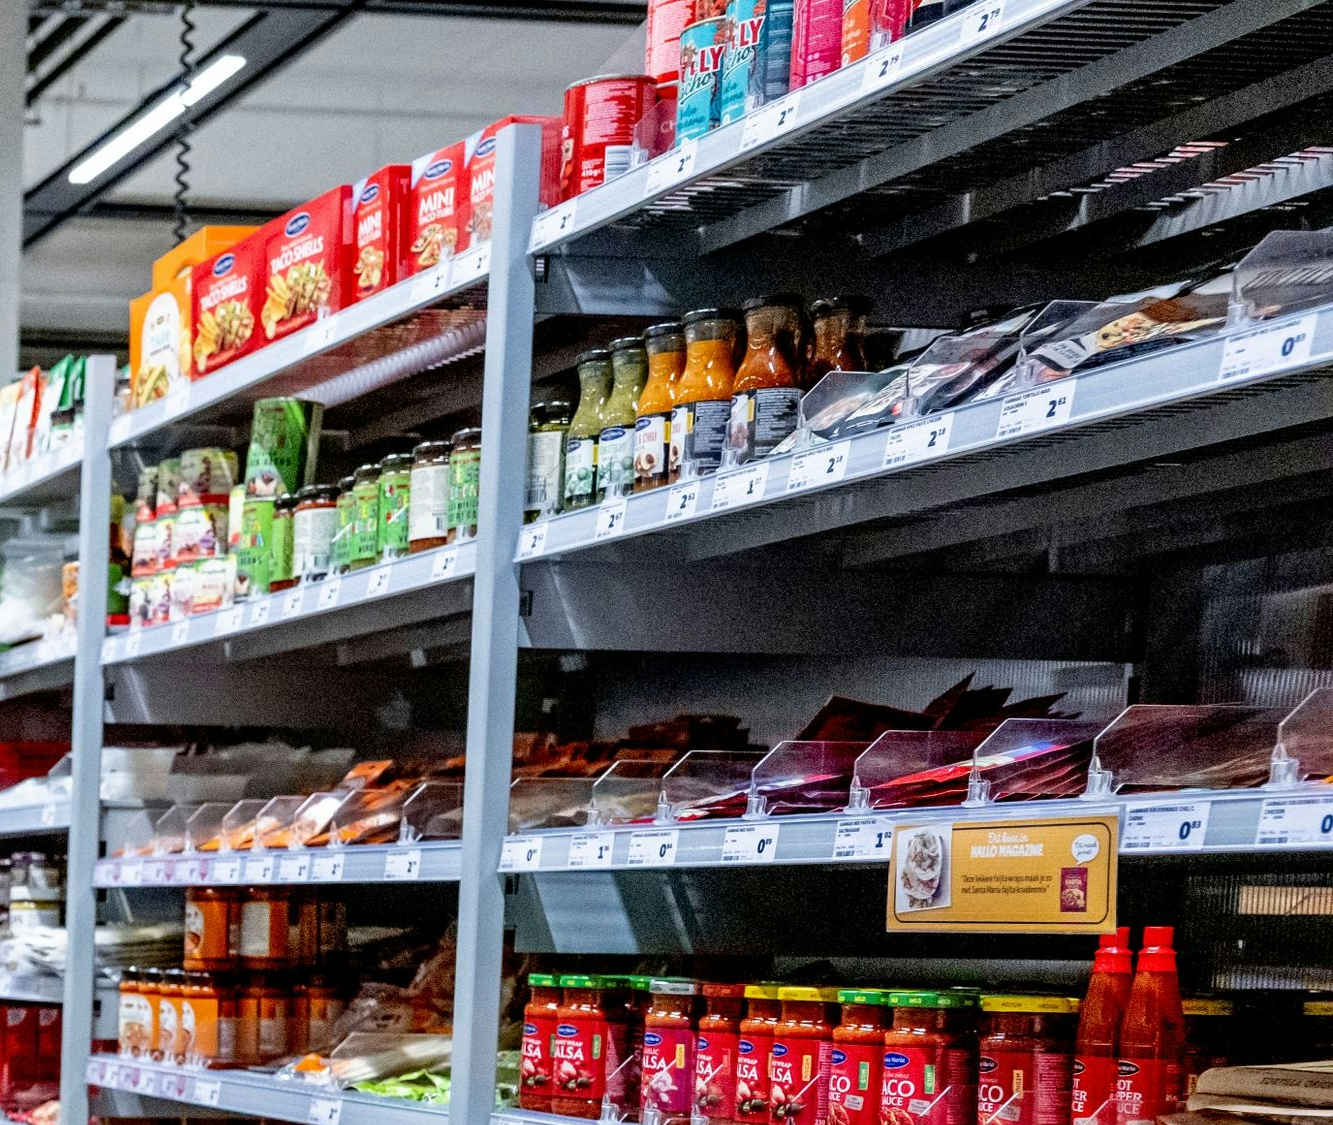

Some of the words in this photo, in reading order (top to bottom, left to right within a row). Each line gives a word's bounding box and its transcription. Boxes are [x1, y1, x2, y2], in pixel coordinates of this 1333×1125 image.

[420, 187, 455, 217] MINI
[292, 234, 324, 265] SHELLS
[970, 845, 998, 858] HALLO
[999, 843, 1044, 858] MAGAZINE
